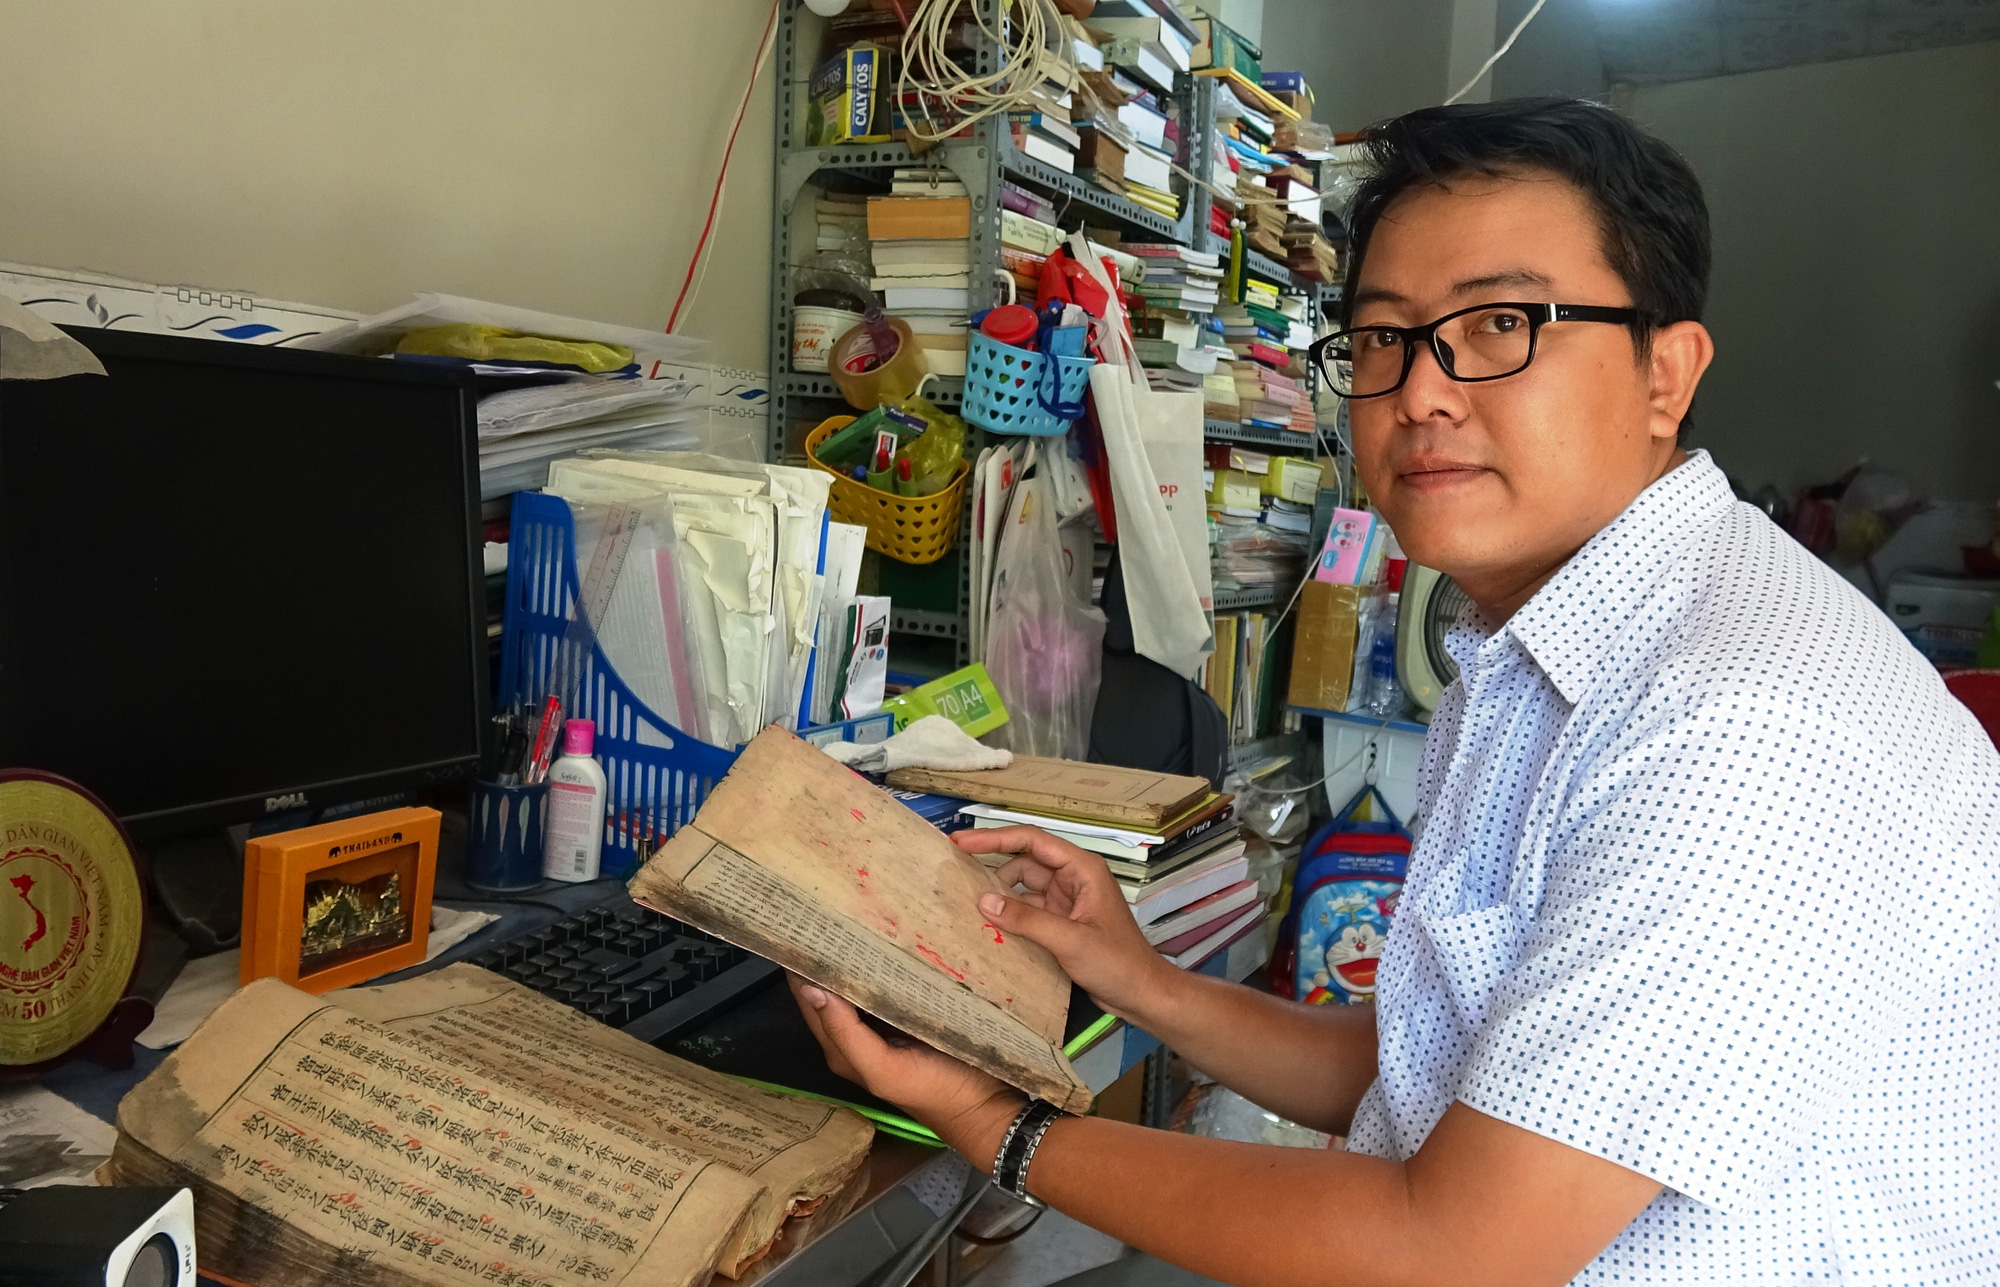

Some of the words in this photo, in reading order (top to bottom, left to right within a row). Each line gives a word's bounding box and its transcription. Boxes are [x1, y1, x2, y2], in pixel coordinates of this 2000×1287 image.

[855, 63, 869, 126] CALYTOS
[936, 695, 959, 718] 70
[962, 685, 982, 711] A4
[265, 792, 308, 813] DELL
[43, 829, 78, 853] GIAN
[343, 836, 390, 854] THAILAND
[21, 1000, 46, 1020] 50
